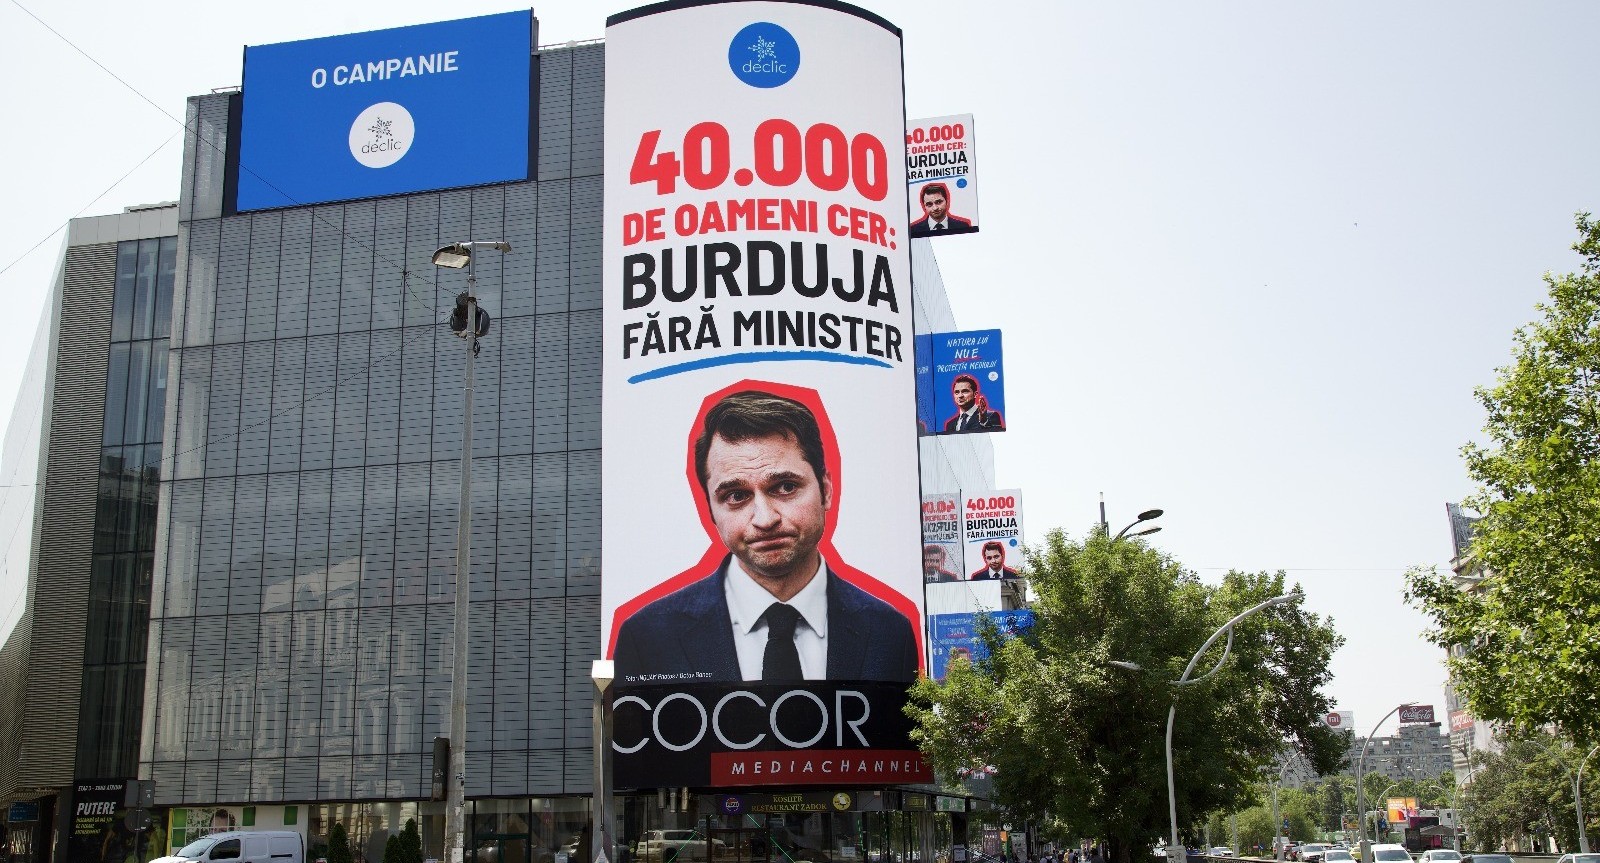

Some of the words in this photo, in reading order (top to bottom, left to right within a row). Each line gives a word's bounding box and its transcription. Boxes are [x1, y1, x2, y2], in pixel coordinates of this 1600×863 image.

[311, 68, 327, 88] O
[333, 50, 459, 86] CAMPANIE
[742, 60, 787, 75] declic
[361, 138, 402, 154] declic
[912, 143, 945, 154] OAMENI
[946, 141, 967, 151] CER:
[629, 119, 889, 201] 40.000
[908, 150, 968, 168] URDUJA
[925, 165, 969, 178] MINISTER
[623, 208, 666, 246] DE
[674, 199, 818, 236] OAMENI
[827, 203, 897, 250] CER:
[622, 241, 899, 313] BURDUJA
[623, 304, 721, 359] FĂRĂ
[733, 310, 903, 362] MINISTER
[947, 337, 976, 348] NATURA
[967, 496, 1015, 511] 40.000
[965, 512, 975, 520] DE
[975, 511, 1001, 519] OAMENI
[966, 517, 1018, 531] BURDUJA
[986, 529, 1019, 538] MINISTER
[612, 689, 870, 754] COCOR
[731, 760, 920, 775] MEDIACHANNEL
[76, 801, 117, 816] PUTERE
[751, 803, 799, 812] RESTAURANT
